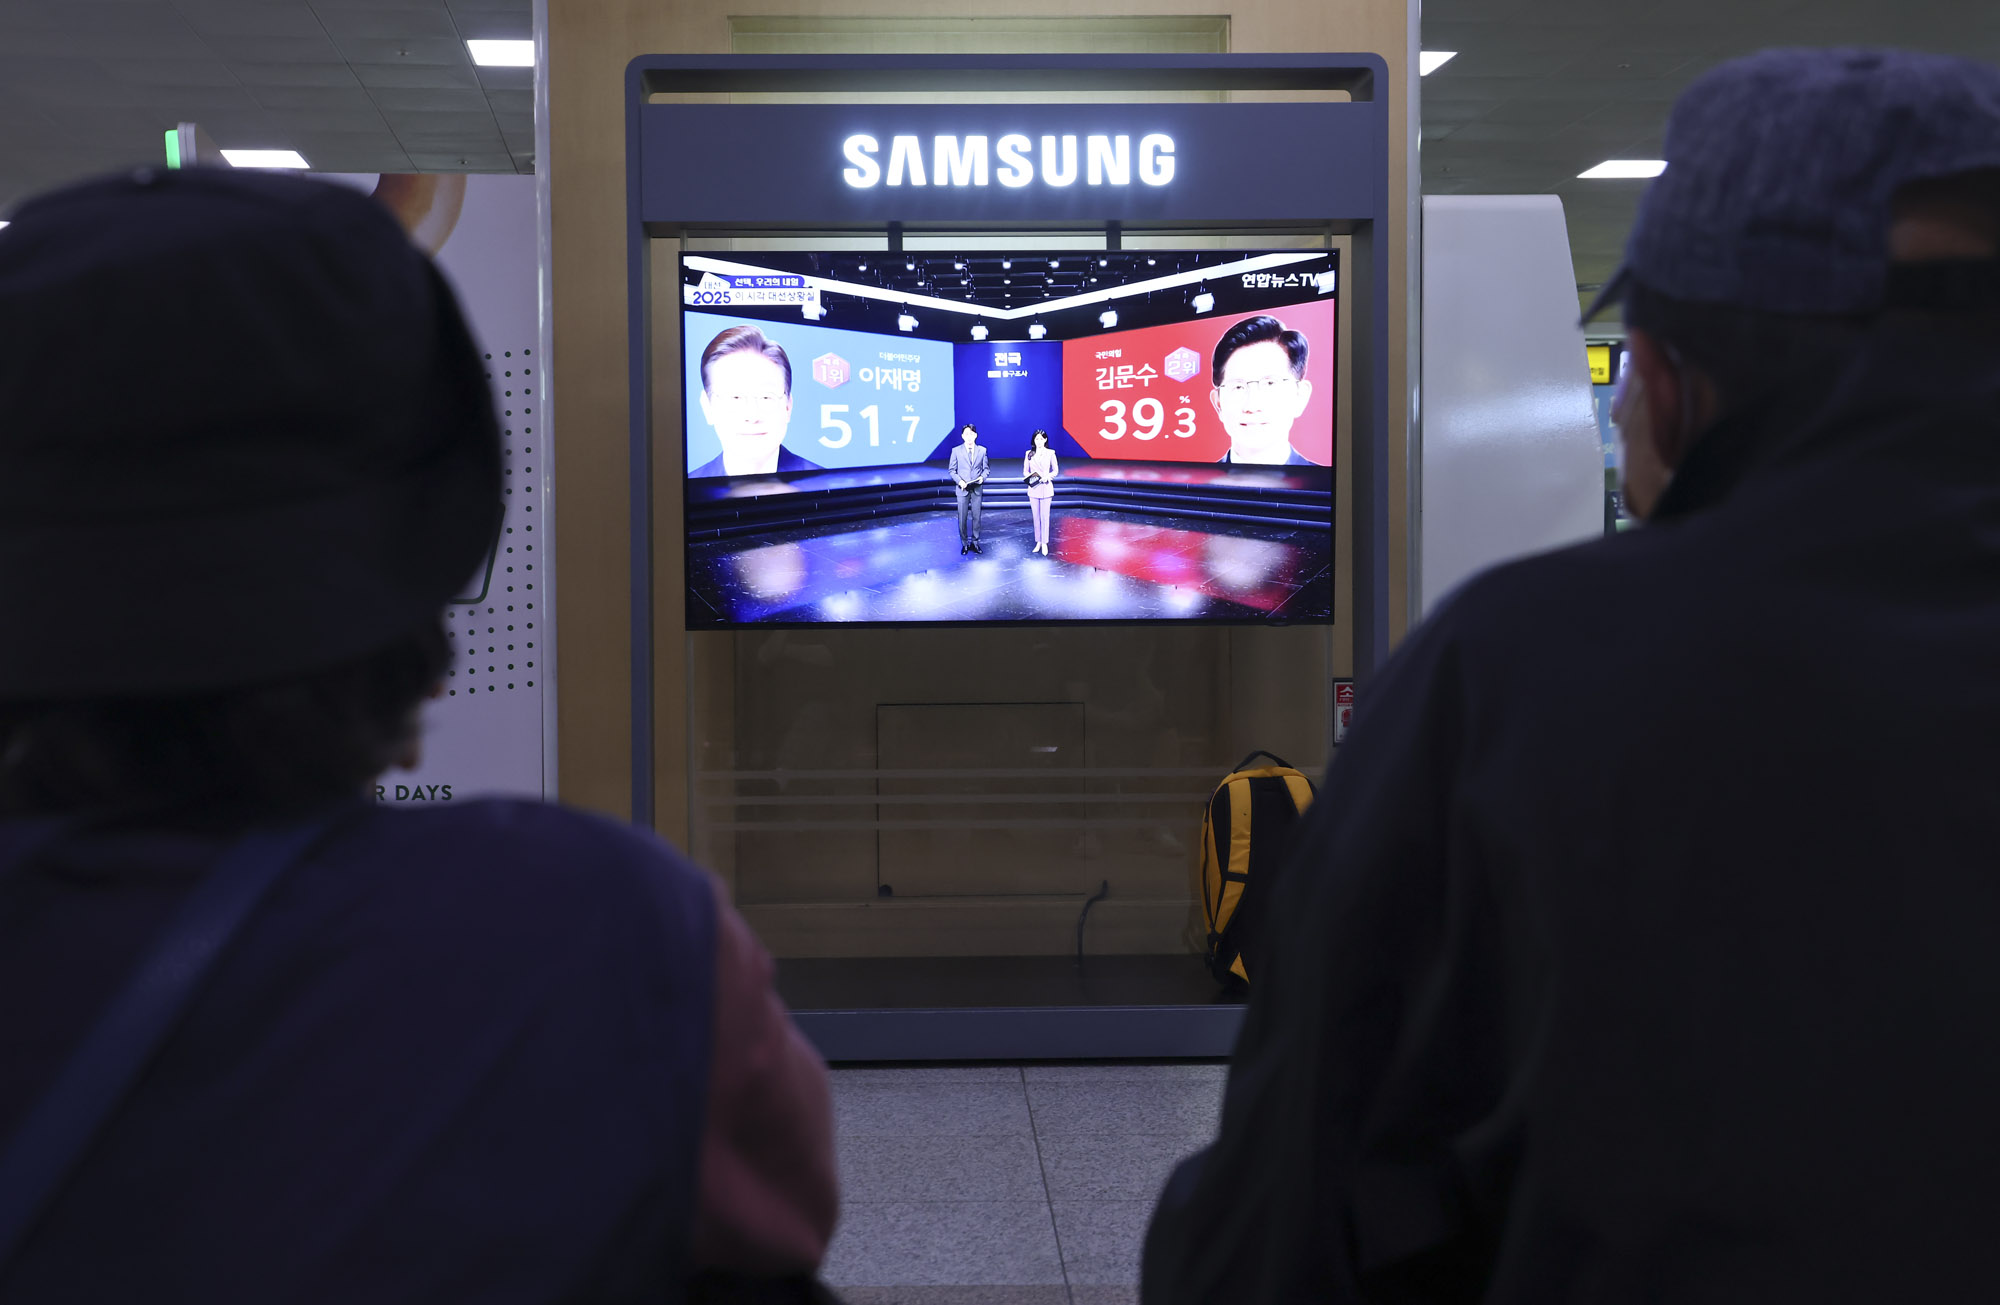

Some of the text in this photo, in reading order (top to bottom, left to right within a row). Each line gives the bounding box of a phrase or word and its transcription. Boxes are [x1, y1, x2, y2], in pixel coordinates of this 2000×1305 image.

[843, 134, 1175, 188] SAMSUNG
[755, 277, 781, 287] 우리의
[782, 277, 799, 287] 내일
[1241, 273, 1319, 288] 연합뉴스TV
[693, 291, 731, 304] 2025
[735, 291, 744, 302] 이
[748, 291, 765, 302] 시각
[879, 351, 921, 364] 더불어민주당
[994, 352, 1021, 366] 전국
[1095, 348, 1122, 360] 국민의힘
[820, 364, 844, 383] 1위
[1167, 360, 1196, 376] 2위
[858, 366, 921, 392] 이재명
[1095, 363, 1159, 390] 김문수
[818, 404, 921, 449] 51.7
[1098, 397, 1197, 440] 39.3
[395, 785, 453, 801] DAYS
